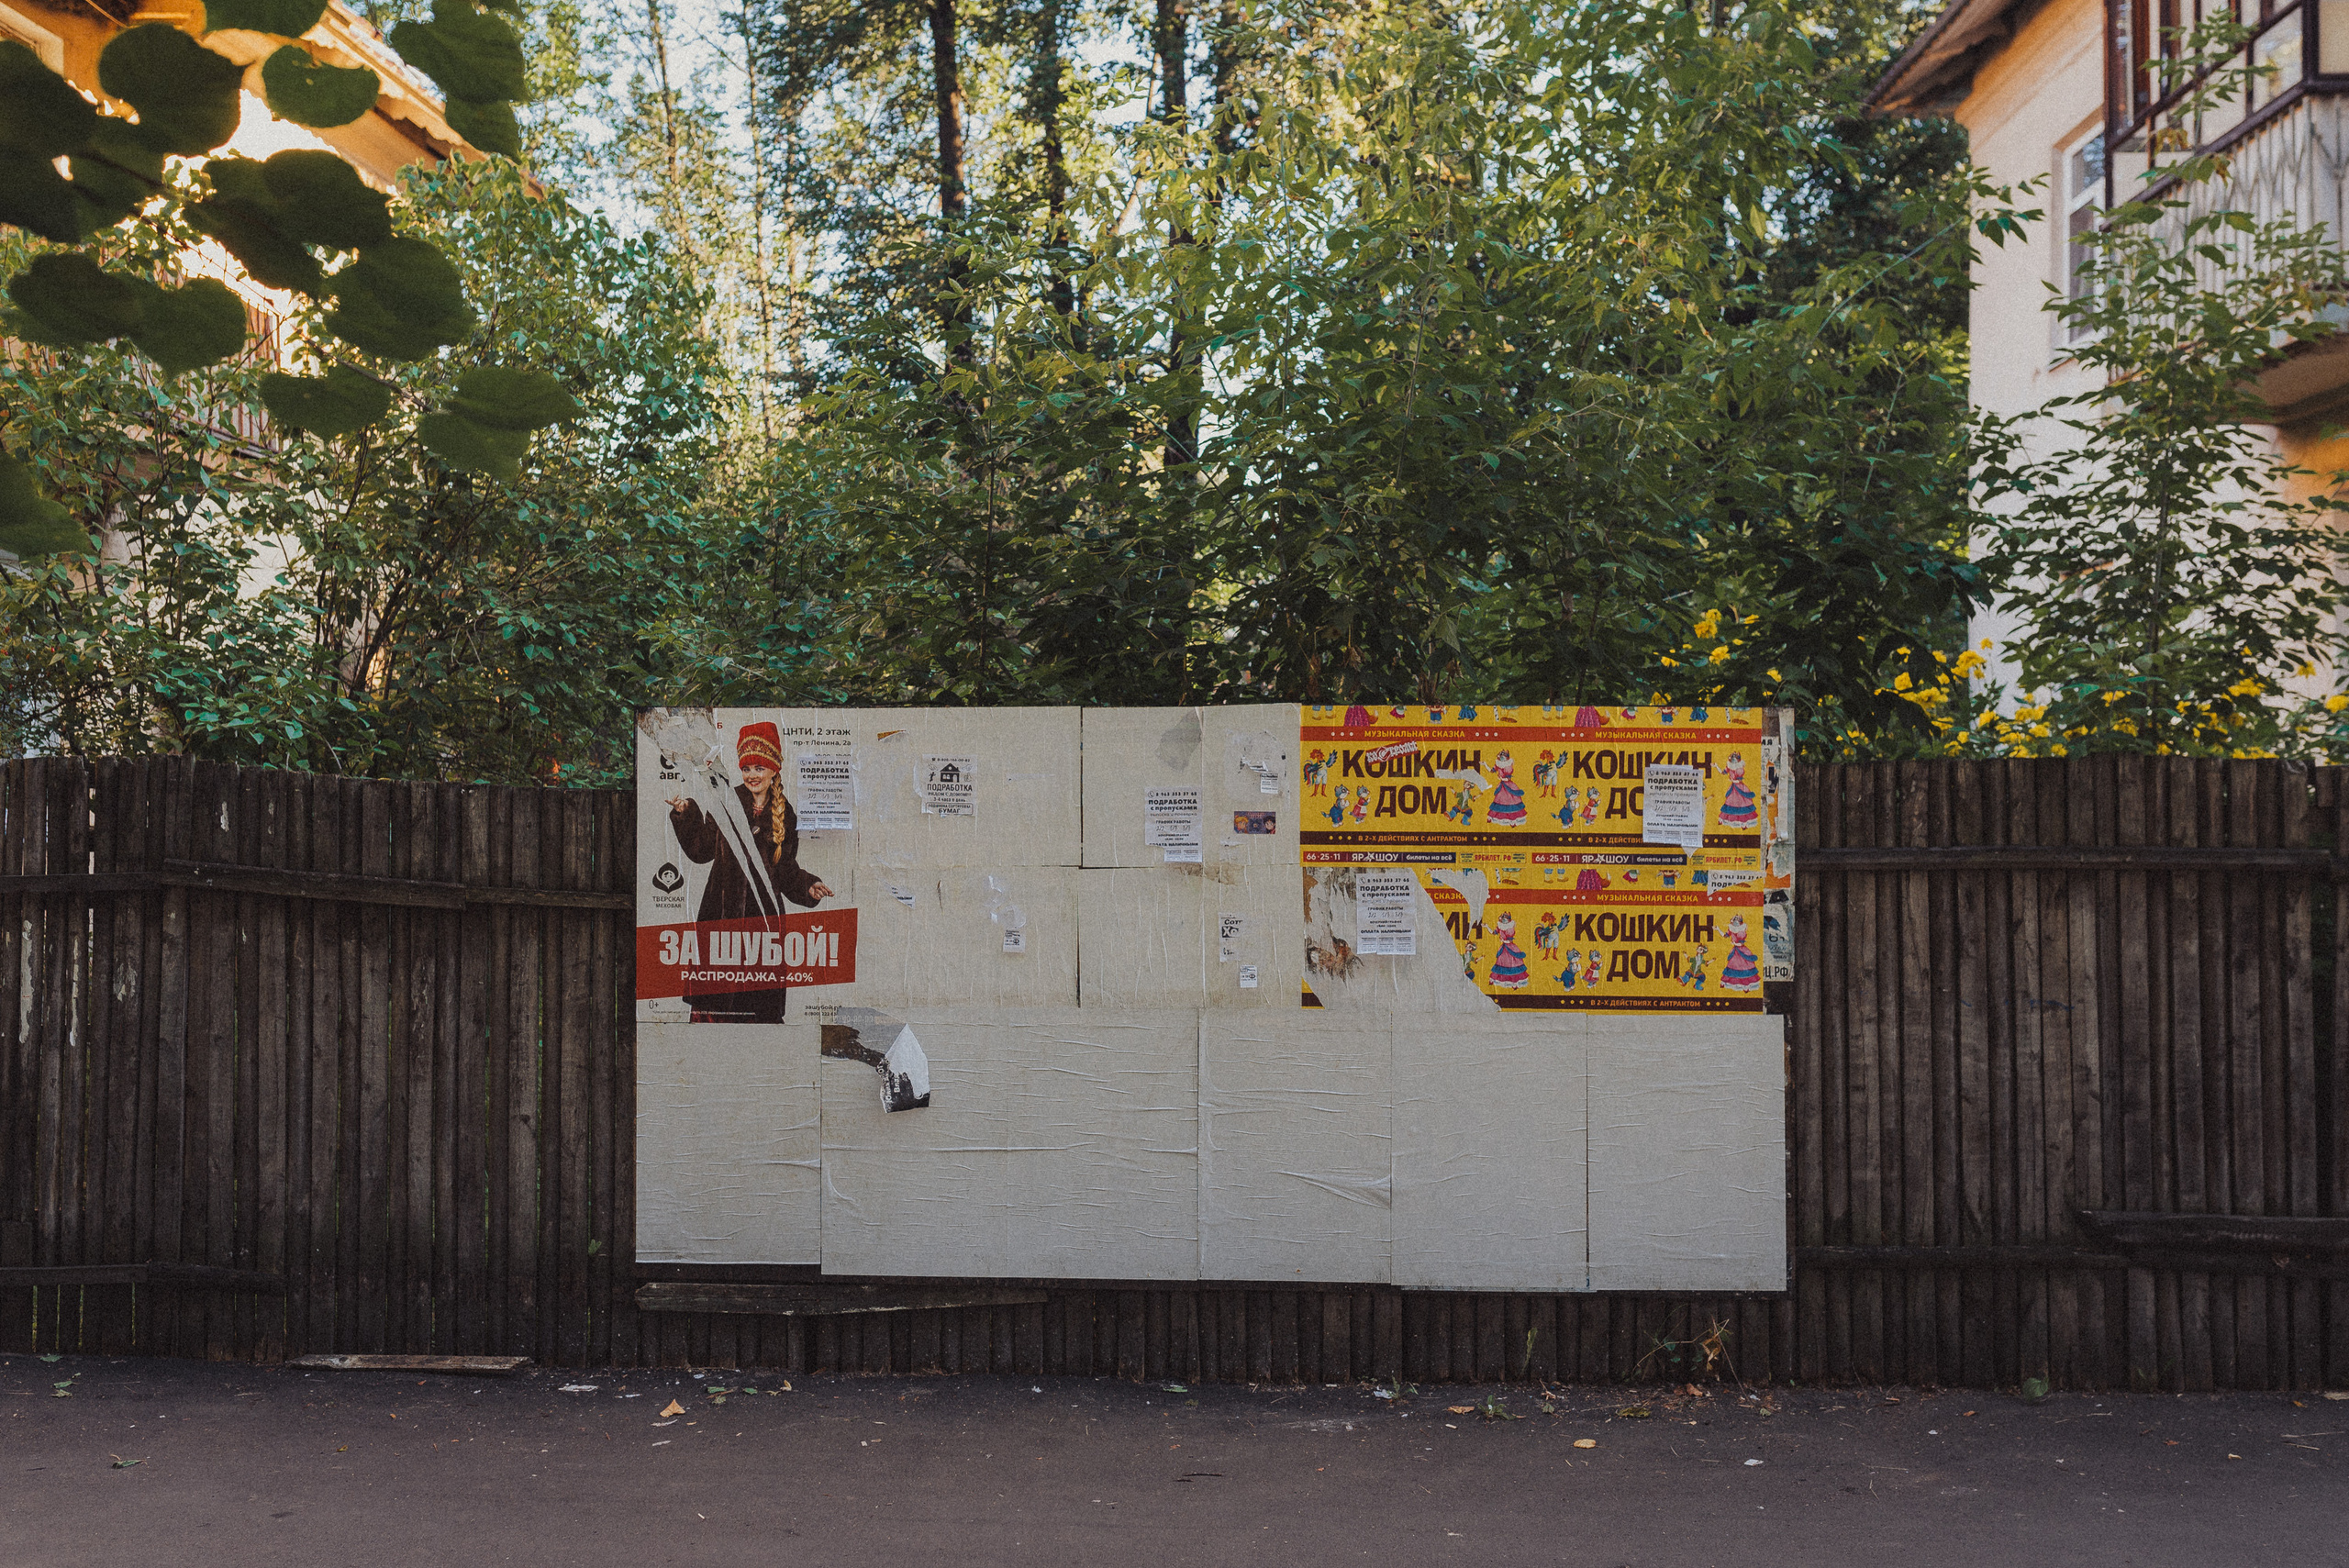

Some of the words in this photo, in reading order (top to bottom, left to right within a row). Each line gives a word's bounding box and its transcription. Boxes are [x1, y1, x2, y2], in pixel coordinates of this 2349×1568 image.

[783, 728, 815, 737] ЦНТИ,
[817, 728, 823, 736] 2
[1342, 750, 1481, 778] КОШКИН
[1375, 784, 1447, 818] ДОМ
[1605, 785, 1644, 819] ДО
[1378, 834, 1419, 842] ДЕЙСТВИЯХ
[1608, 836, 1643, 844] ДЕЙСТВИ
[1375, 853, 1398, 862] ШОУ
[1606, 855, 1630, 863] ШОУ
[1575, 912, 1714, 942] КОШКИН
[659, 929, 701, 966] ЗА
[710, 925, 839, 967] ШУБОЙ!
[1607, 949, 1679, 982] ДОМ
[681, 971, 777, 983] РАСПРОДАЖА
[1764, 966, 1788, 979] Ц.РФ
[649, 999, 659, 1009] 0+
